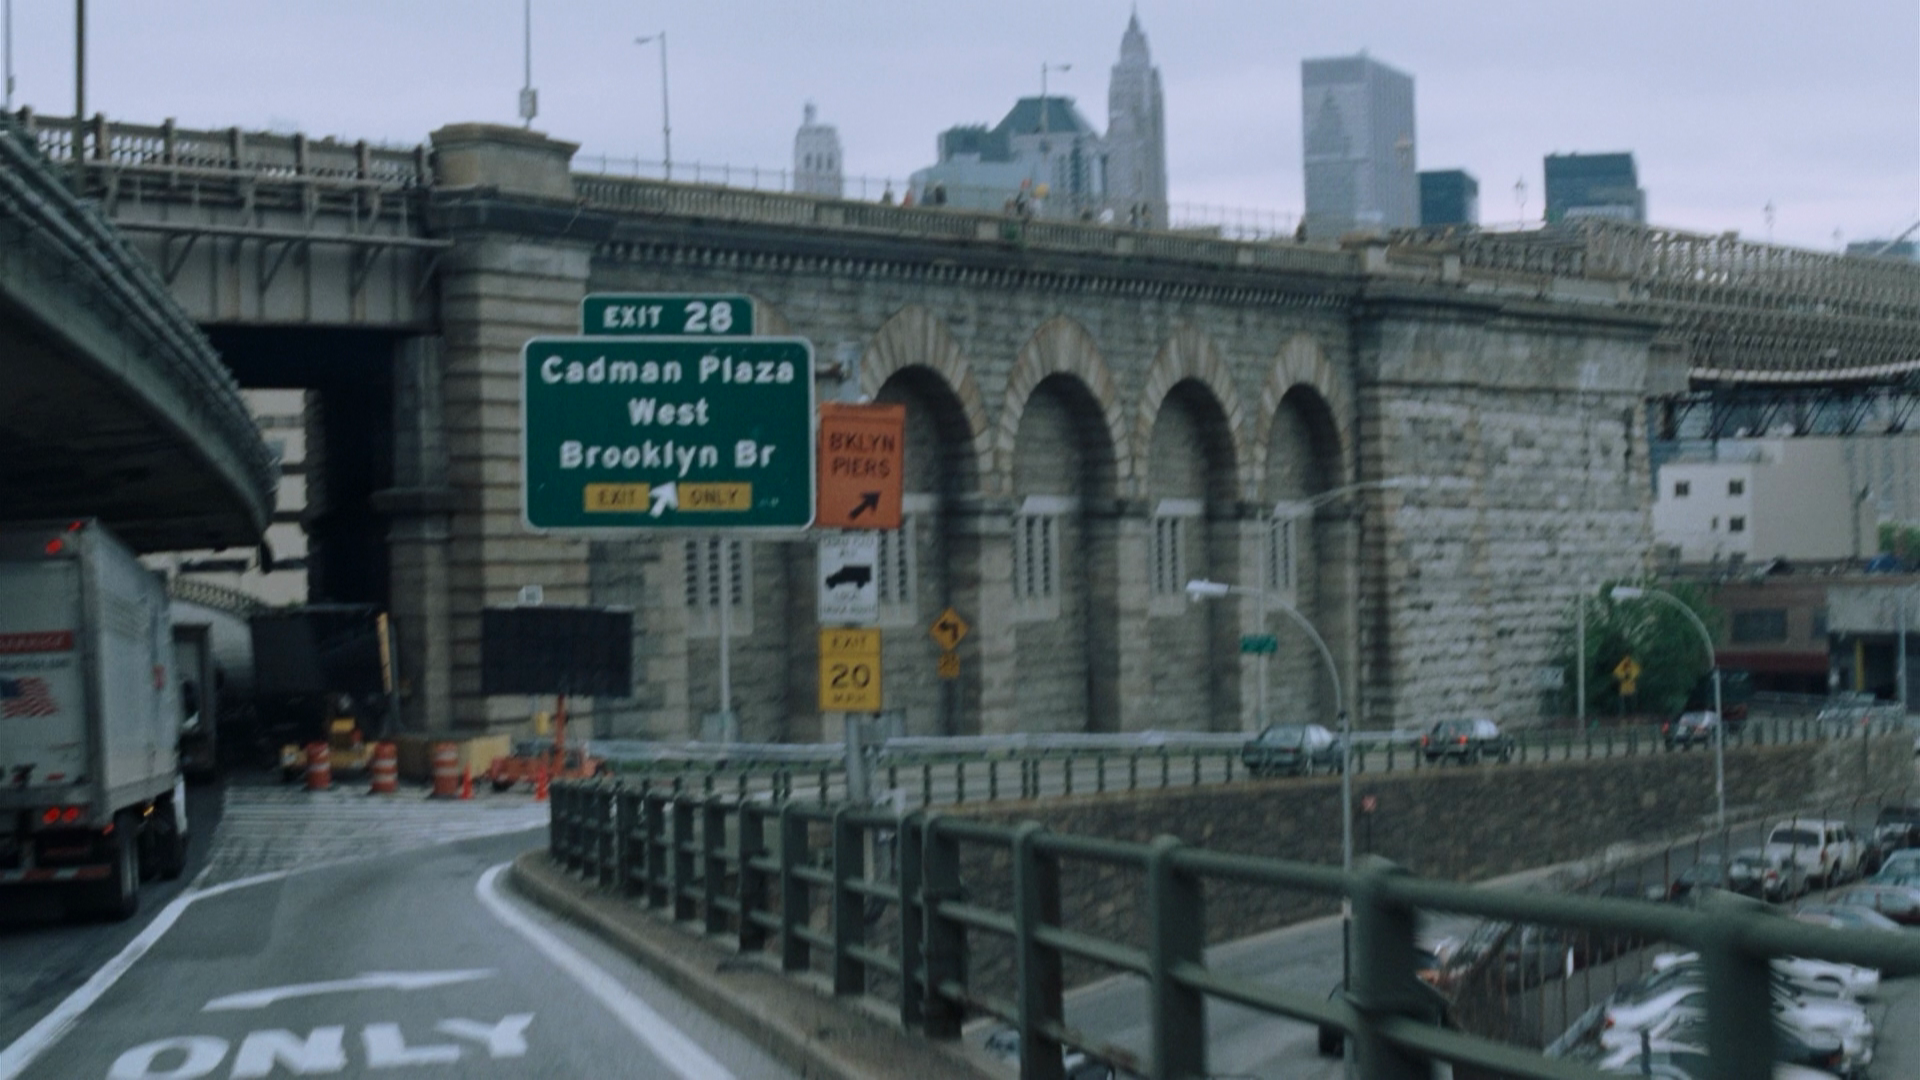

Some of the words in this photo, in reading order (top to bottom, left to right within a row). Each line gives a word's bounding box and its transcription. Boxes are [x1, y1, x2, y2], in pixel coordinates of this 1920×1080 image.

[603, 305, 662, 328] EXIT
[684, 302, 734, 333] 28
[541, 356, 682, 384] Cadman
[700, 356, 794, 384] Plaza
[629, 398, 709, 426] West
[559, 440, 718, 477] Brooklyn
[734, 440, 776, 469] Br
[831, 457, 890, 478] PIERS
[597, 488, 636, 506] EXIT
[690, 488, 739, 505] ONLY
[831, 664, 872, 689] 20
[106, 1012, 536, 1080] ONLY
